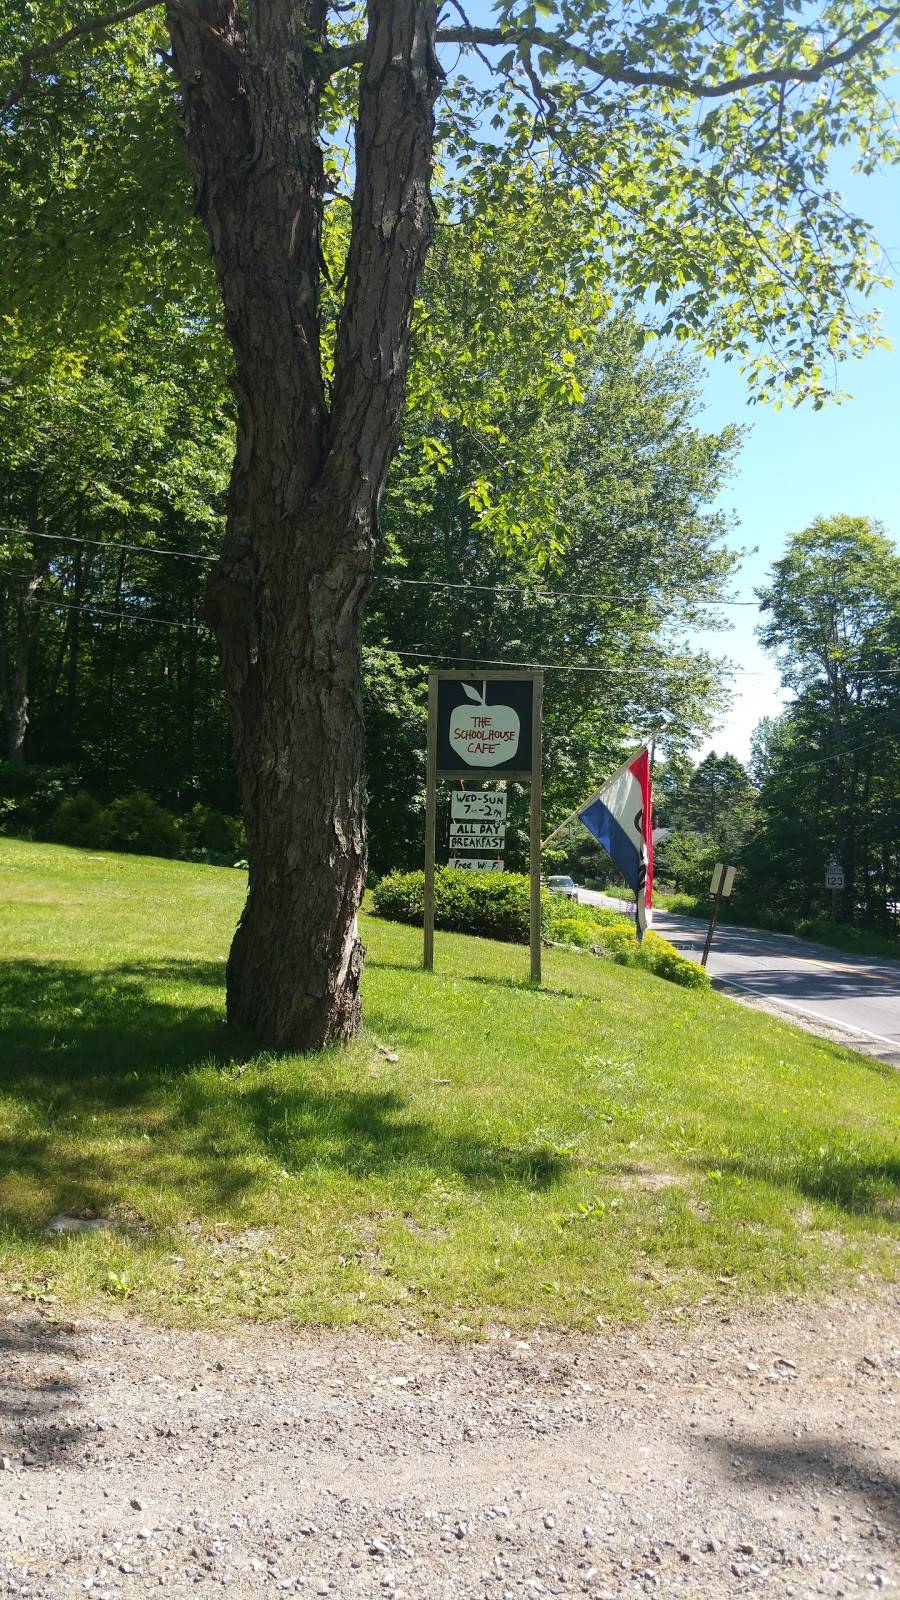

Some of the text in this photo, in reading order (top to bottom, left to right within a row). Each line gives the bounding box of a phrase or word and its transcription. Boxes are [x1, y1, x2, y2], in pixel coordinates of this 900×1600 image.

[470, 716, 493, 729] THE
[453, 728, 516, 742] SCHOOLHOUSE
[456, 824, 500, 835] ALL DAY
[451, 837, 505, 848] BREAKFAST
[454, 859, 472, 870] Free
[827, 876, 843, 886] 123
